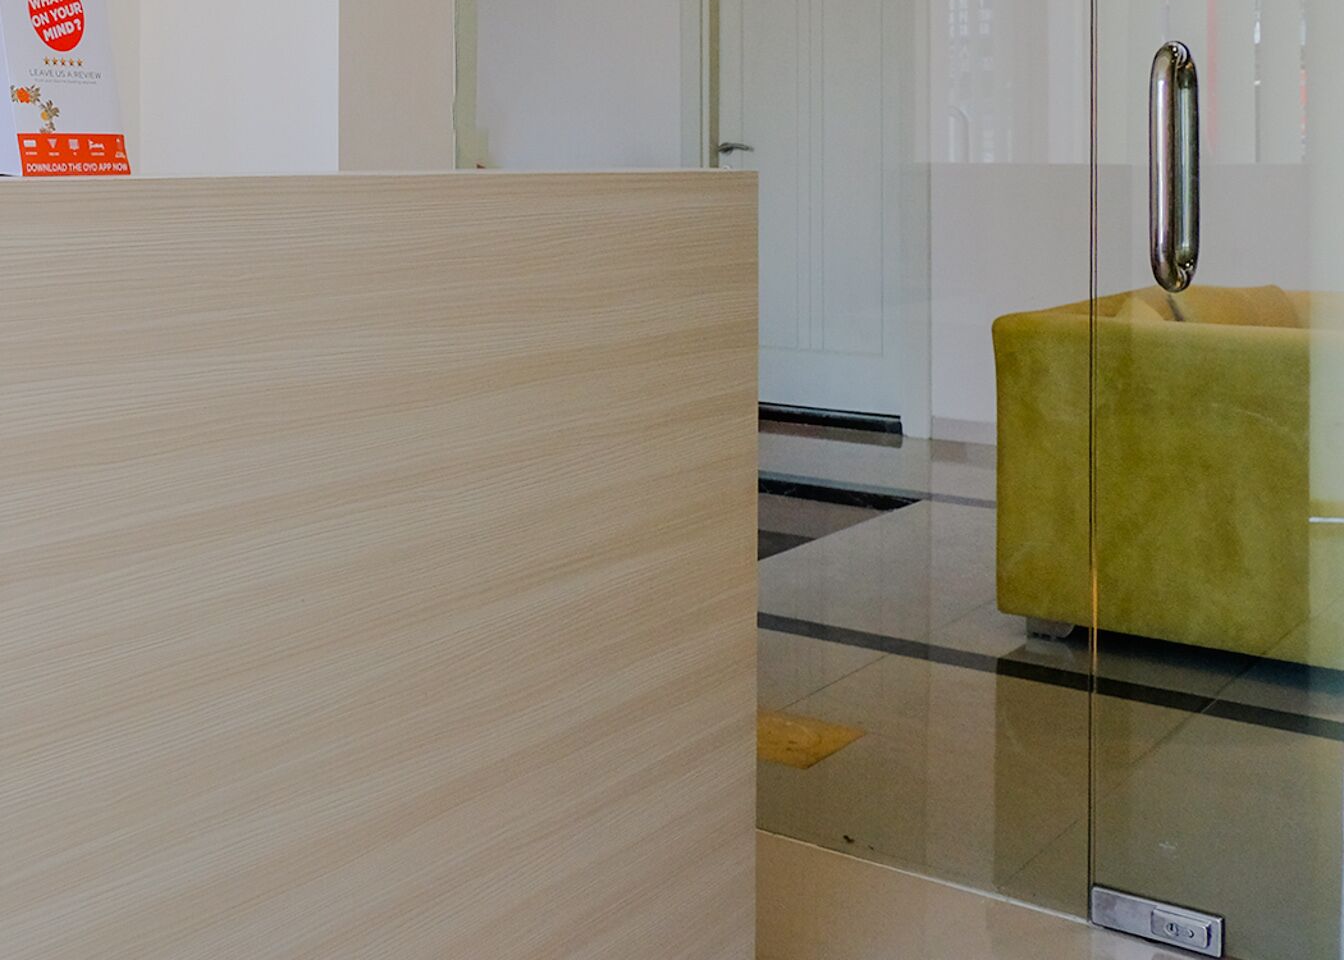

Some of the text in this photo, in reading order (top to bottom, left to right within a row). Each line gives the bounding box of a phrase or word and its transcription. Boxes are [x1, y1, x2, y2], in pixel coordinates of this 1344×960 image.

[31, 2, 83, 28] ON YOUR
[42, 18, 82, 41] MIND?
[29, 68, 102, 80] LEAVE US A REVIEW
[26, 162, 128, 173] DOWNLOAD THE OYO APP NOW
